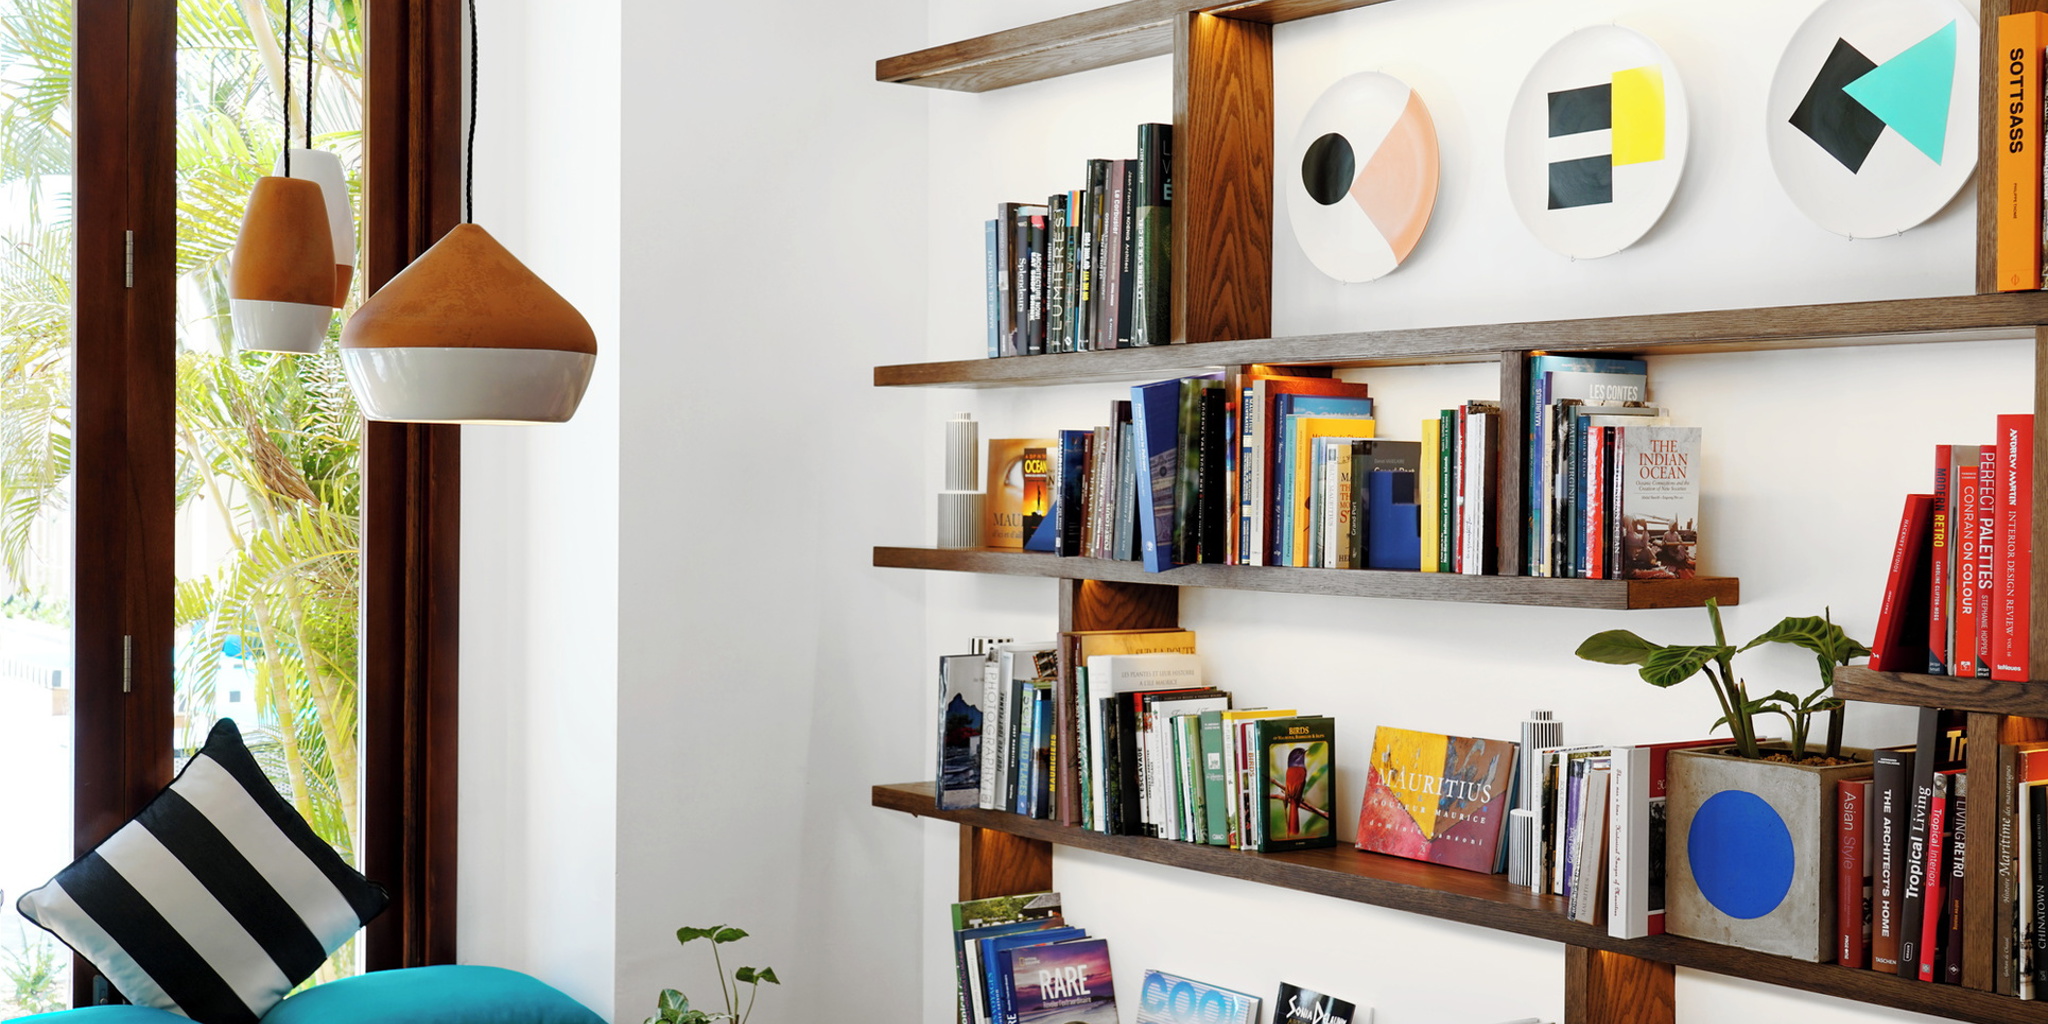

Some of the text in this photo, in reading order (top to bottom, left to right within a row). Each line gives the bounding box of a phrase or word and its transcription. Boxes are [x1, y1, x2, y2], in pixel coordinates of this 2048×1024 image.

[2009, 48, 2024, 154] SOTTSASS
[1111, 189, 1120, 235] Le Corbusier
[1017, 257, 1026, 313] Splendeurs
[1082, 291, 1089, 301] ON
[1589, 383, 1638, 401] LES CONTES
[1568, 422, 1576, 448] PAUL
[1649, 439, 1678, 453] THE
[2008, 427, 2018, 469] ANDREW
[1638, 452, 1688, 466] INDIAN
[1639, 466, 1687, 480] OCEAN
[1567, 460, 1575, 506] VIRGINIE
[1934, 467, 1946, 513] MODERN
[2008, 470, 2018, 505] MARTIN
[1933, 514, 1945, 548] RETRO
[1962, 485, 1974, 539] CONRAN
[1892, 518, 1910, 573] HACKNEY STUDIOS
[1962, 541, 1974, 560] ON
[1978, 452, 1995, 656] PERFECT PALETTES STEPHANIE HOPPEN
[2006, 510, 2017, 558] INTERIOR
[1962, 563, 1973, 615] COLOUR
[2006, 560, 2016, 597] DESIGN
[2005, 599, 2015, 637] REVIEW
[984, 671, 998, 785] PHOTOGRAPHY
[1288, 726, 1309, 735] BIRDS
[1019, 737, 1030, 797] WILD PLACES
[1049, 734, 1057, 792] MAURICIENS
[1137, 746, 1145, 799] L'ESCLAVAGE
[1247, 752, 1255, 777] BIRDS
[1375, 768, 1493, 805] MAURITIUS
[2002, 764, 2013, 804] mascareignes
[1372, 798, 1487, 825] COULEUR MAURICE
[1843, 790, 1856, 831] Asian
[1954, 799, 1966, 841] LIVING
[2002, 804, 2011, 817] des
[1841, 835, 1856, 870] Style
[1906, 785, 1932, 899] Tropical Living
[1928, 808, 1943, 887] Tropical Interiors
[1952, 841, 1965, 878] RETRO
[1998, 817, 2012, 877] Maritime
[1881, 789, 1892, 938] THE ARCHITECT'S HOME
[2037, 885, 2047, 950] CHINATOWN
[1874, 956, 1897, 966] TASCHEN
[987, 972, 998, 1014] VOYAGES
[1038, 964, 1091, 1001] RARE
[1285, 994, 1312, 1021] SONIA
